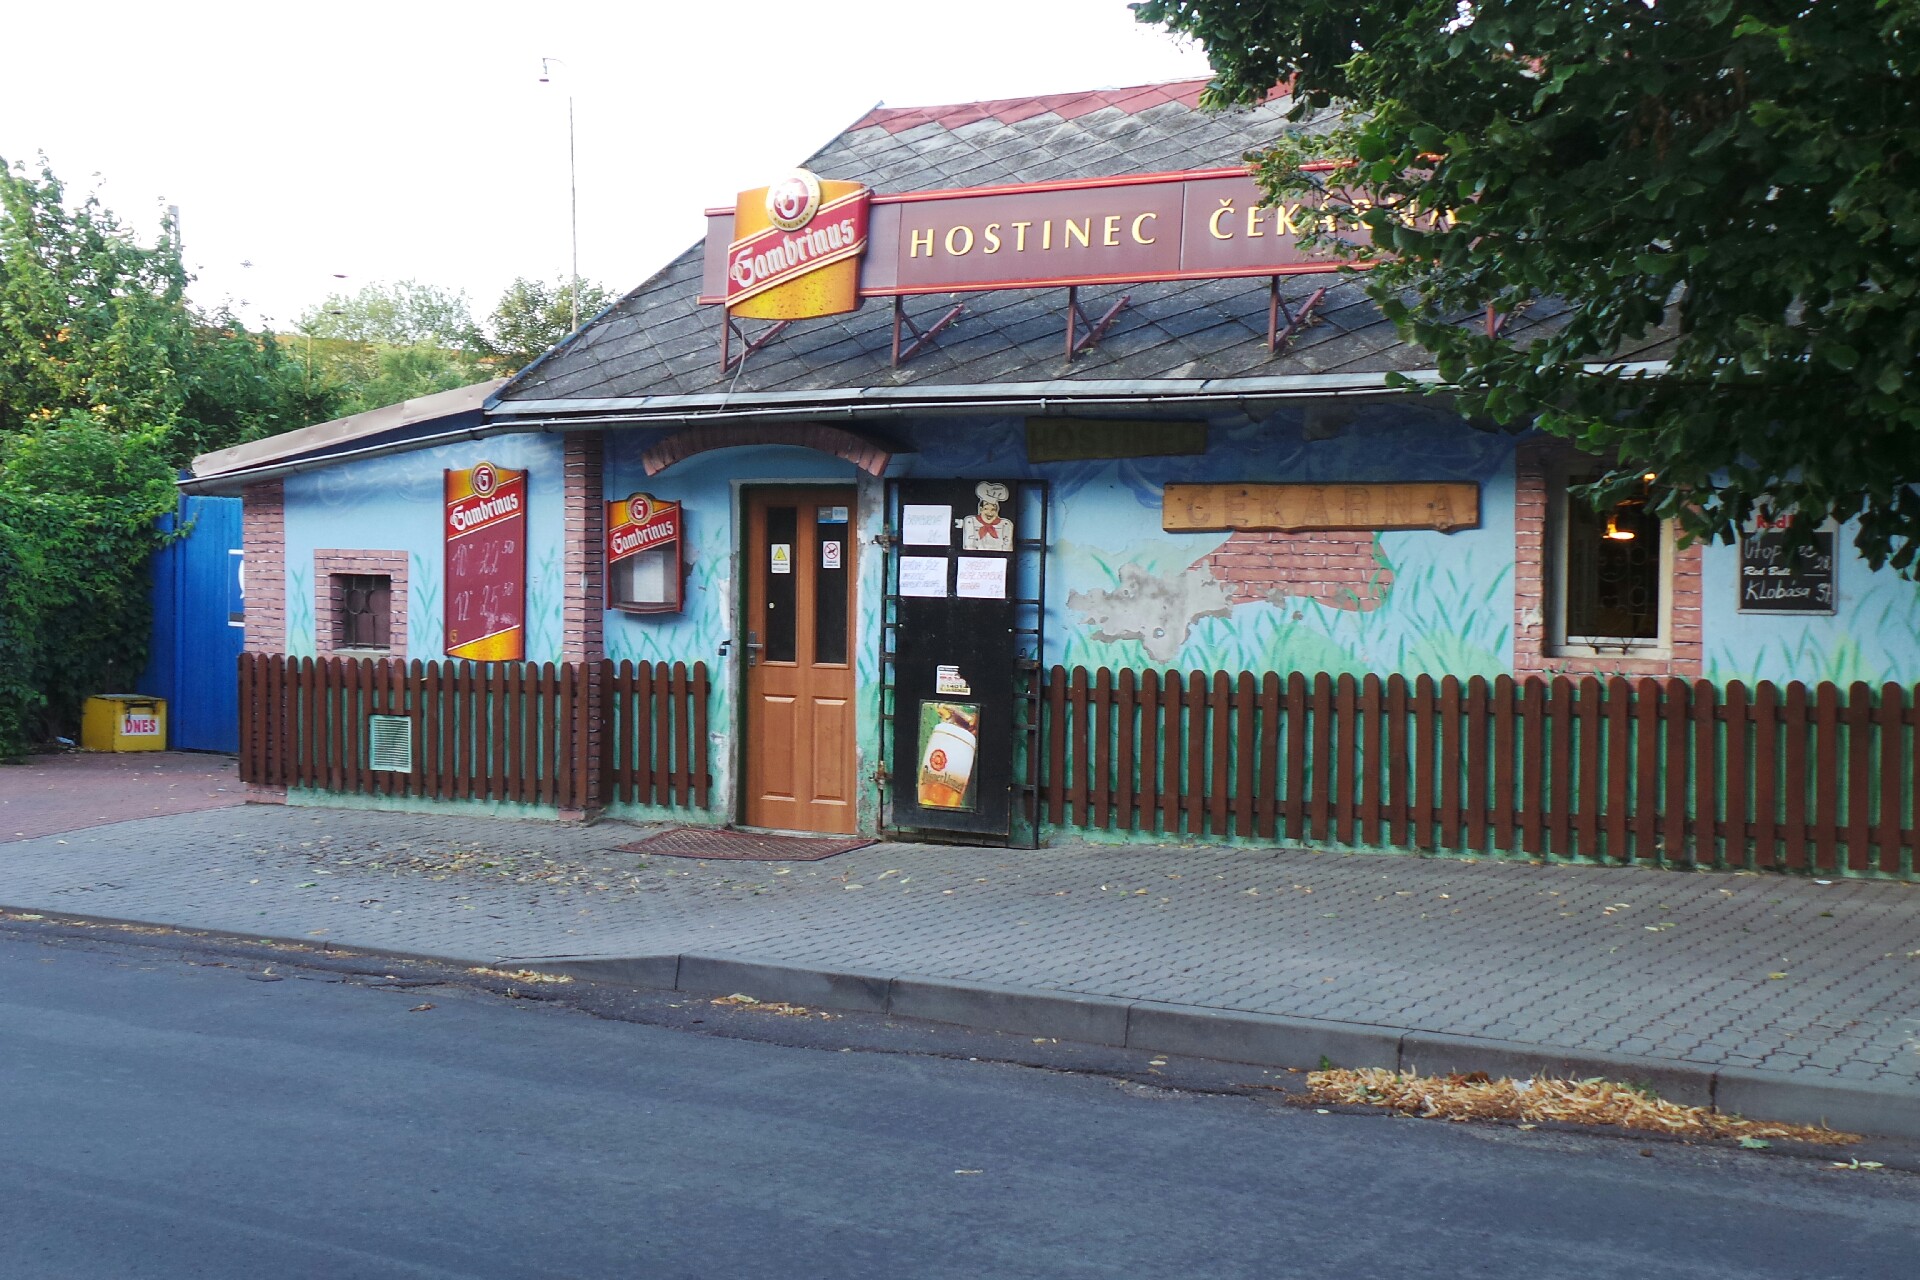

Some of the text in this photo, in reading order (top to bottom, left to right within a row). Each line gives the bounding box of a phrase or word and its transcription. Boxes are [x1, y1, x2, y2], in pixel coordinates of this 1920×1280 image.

[730, 218, 856, 288] Gambrinus
[910, 212, 1157, 258] HOSTINEC
[450, 492, 519, 531] Gambrinus
[611, 520, 674, 554] Gambrinus
[125, 719, 156, 733] DNES
